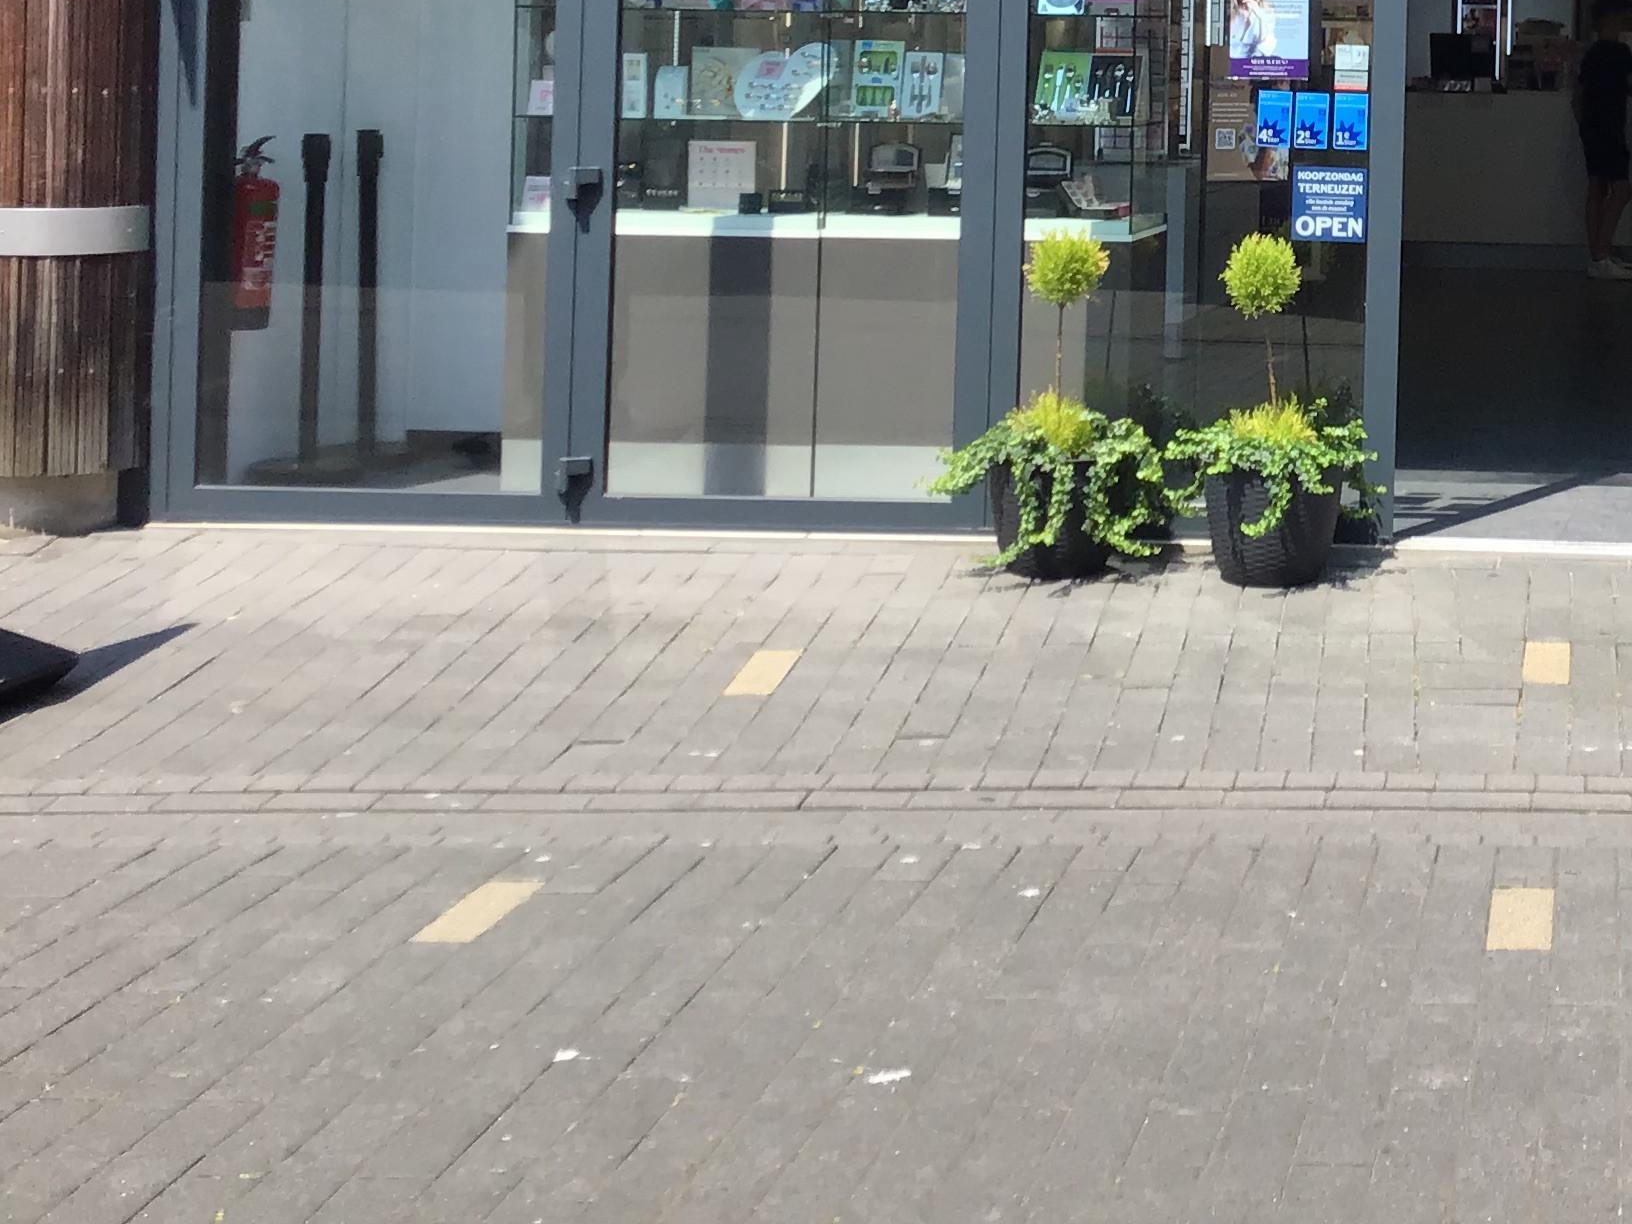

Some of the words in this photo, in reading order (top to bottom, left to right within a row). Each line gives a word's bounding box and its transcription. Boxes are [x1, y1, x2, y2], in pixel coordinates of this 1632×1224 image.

[1297, 171, 1364, 182] KOOPZONDAG
[1297, 182, 1364, 195] TERNEUZEN
[1295, 215, 1363, 238] OPEN
